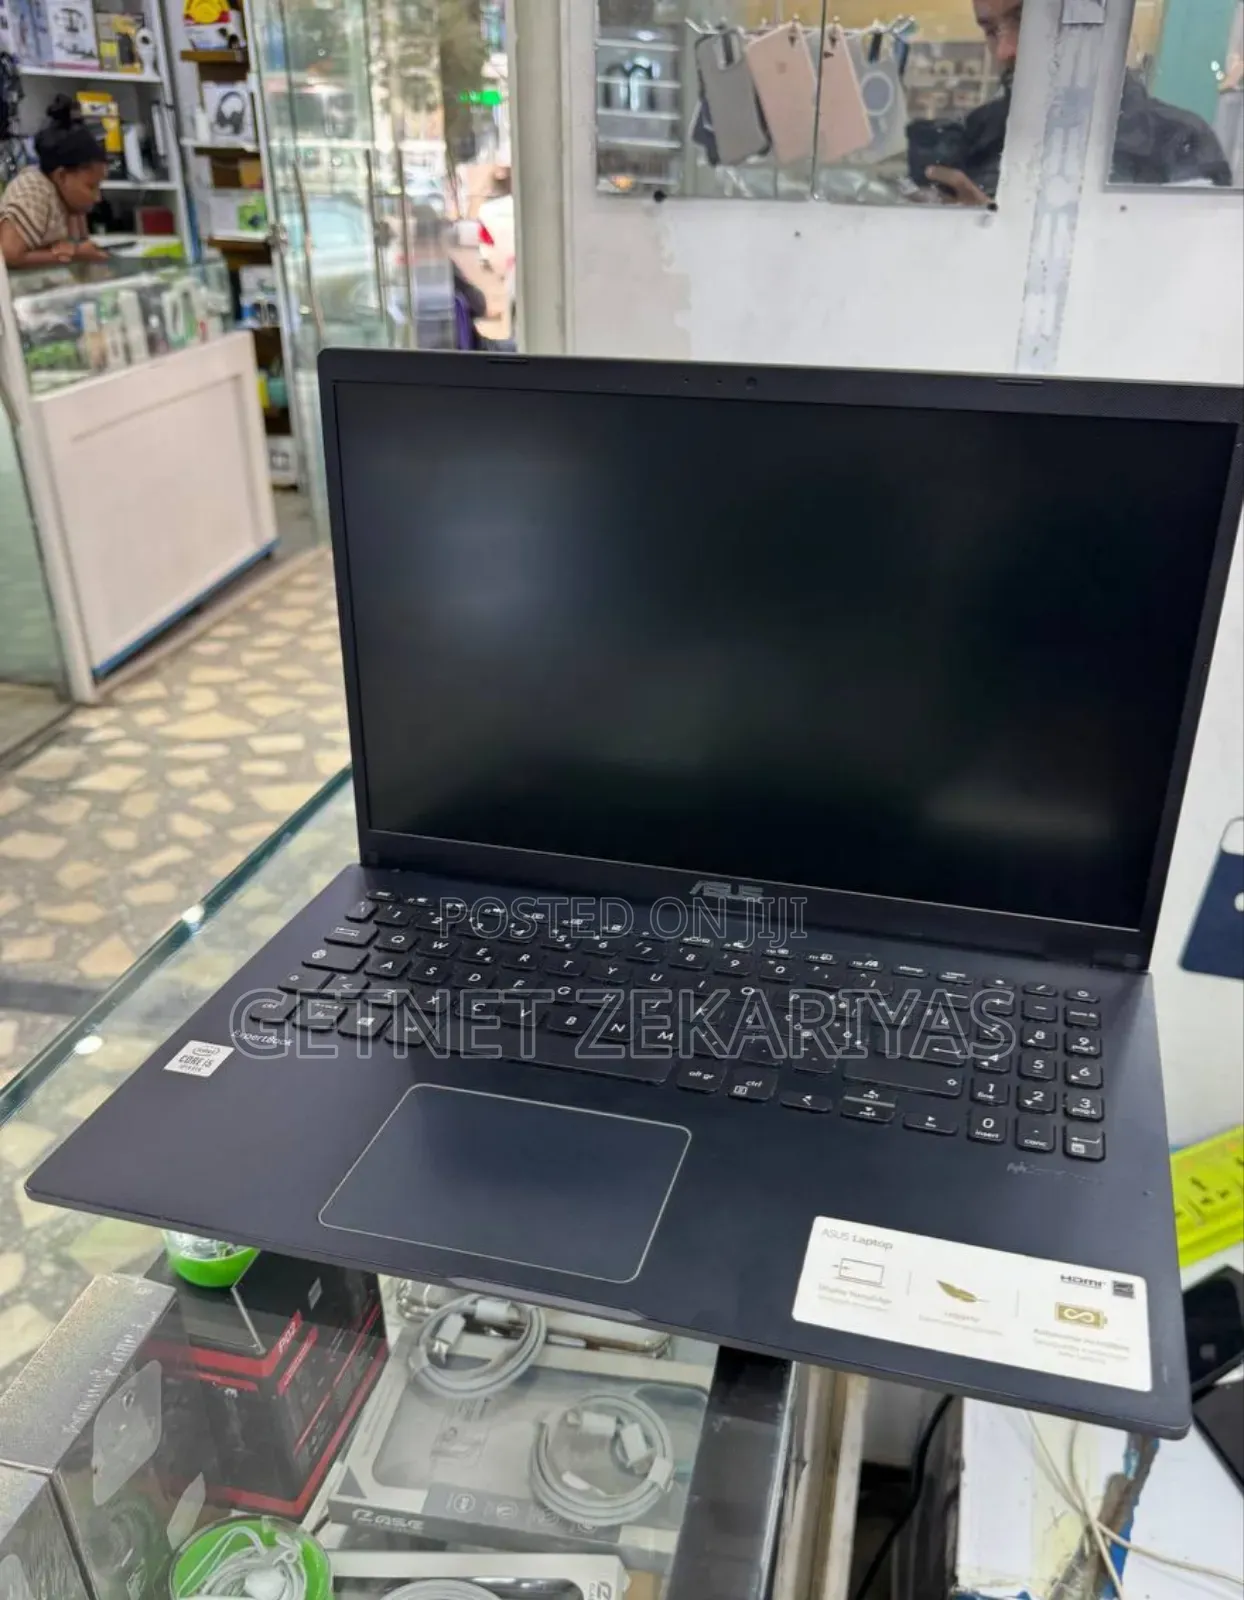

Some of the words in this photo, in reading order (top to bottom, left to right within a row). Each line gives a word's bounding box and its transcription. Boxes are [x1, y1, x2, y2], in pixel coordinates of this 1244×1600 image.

[690, 879, 763, 902] ASUS
[433, 940, 449, 950] W
[476, 947, 488, 957] E
[519, 953, 531, 963] R
[380, 961, 394, 970] A
[563, 959, 574, 969] T
[426, 966, 438, 975] S
[607, 966, 619, 975] Y
[468, 973, 482, 982] D
[650, 973, 664, 982] U
[513, 979, 525, 988] F
[557, 986, 572, 996] G
[602, 993, 616, 1002] H
[473, 1003, 486, 1012] C
[565, 1015, 578, 1026] B
[610, 1023, 626, 1033] N
[657, 1031, 674, 1041] M
[1034, 1030, 1046, 1040] 8
[1079, 1036, 1090, 1046] 9
[1032, 1059, 1045, 1070] 5
[1079, 1066, 1091, 1077] 6
[745, 1080, 763, 1088] ctrl
[988, 1083, 995, 1093] 1
[1032, 1090, 1045, 1102] 2
[1079, 1098, 1091, 1109] 3
[982, 1117, 995, 1129] 0
[1024, 1139, 1047, 1148] canc
[821, 1227, 850, 1242] ASUS
[851, 1234, 894, 1251] Laptop
[1060, 1274, 1103, 1289] HDMI
